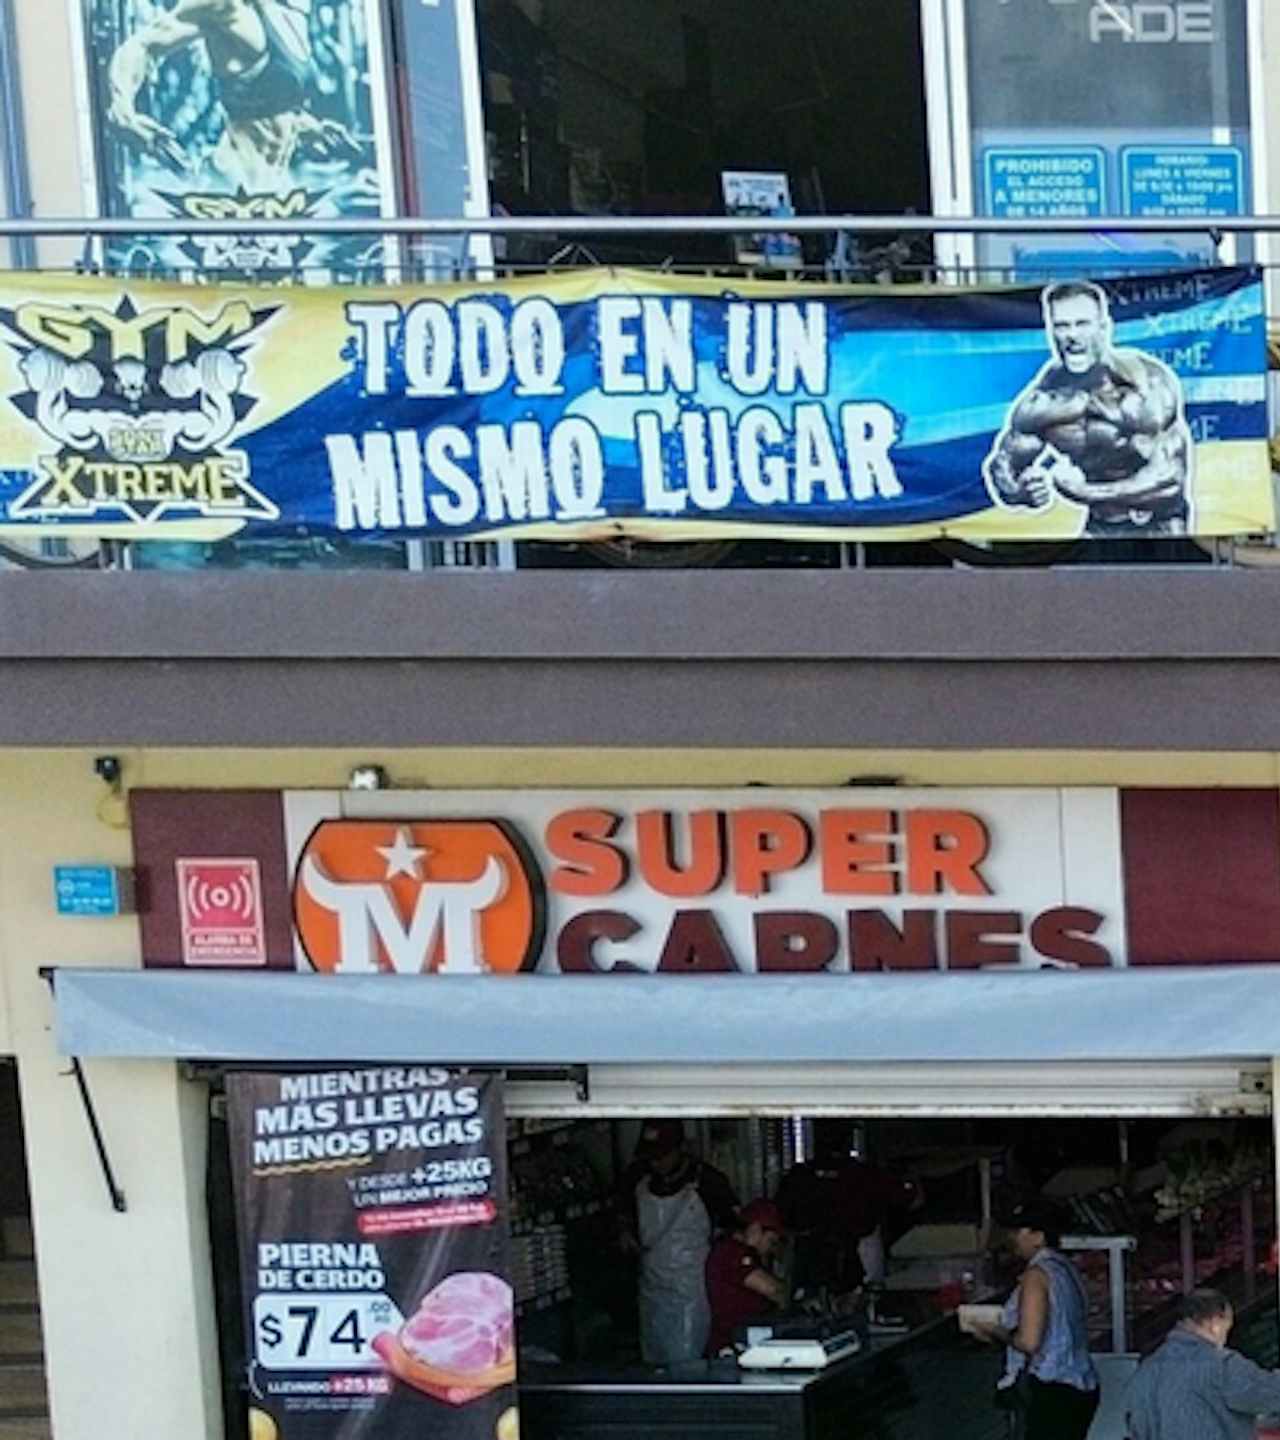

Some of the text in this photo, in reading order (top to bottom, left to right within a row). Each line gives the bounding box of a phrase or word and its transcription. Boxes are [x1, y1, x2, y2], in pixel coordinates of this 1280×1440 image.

[1090, 4, 1213, 43] ADE
[995, 159, 1093, 174] PROHIBIDO
[1028, 175, 1084, 187] ACCESO
[995, 189, 1097, 204] A MENORES
[16, 302, 253, 361] GYM
[347, 295, 830, 397] TODO EN UN
[41, 455, 245, 507] XTREME
[327, 402, 904, 531] MISMO LUGAR
[545, 808, 996, 897] SUPER
[281, 1067, 449, 1099] MIENTRAS
[345, 1087, 479, 1125] LLEVAS
[254, 1118, 485, 1164] MENOS PAGAS
[411, 1157, 492, 1185] +25KG
[258, 1243, 382, 1269] PIERNA
[258, 1269, 385, 1289] DE CERDO
[260, 1306, 366, 1357] $74
